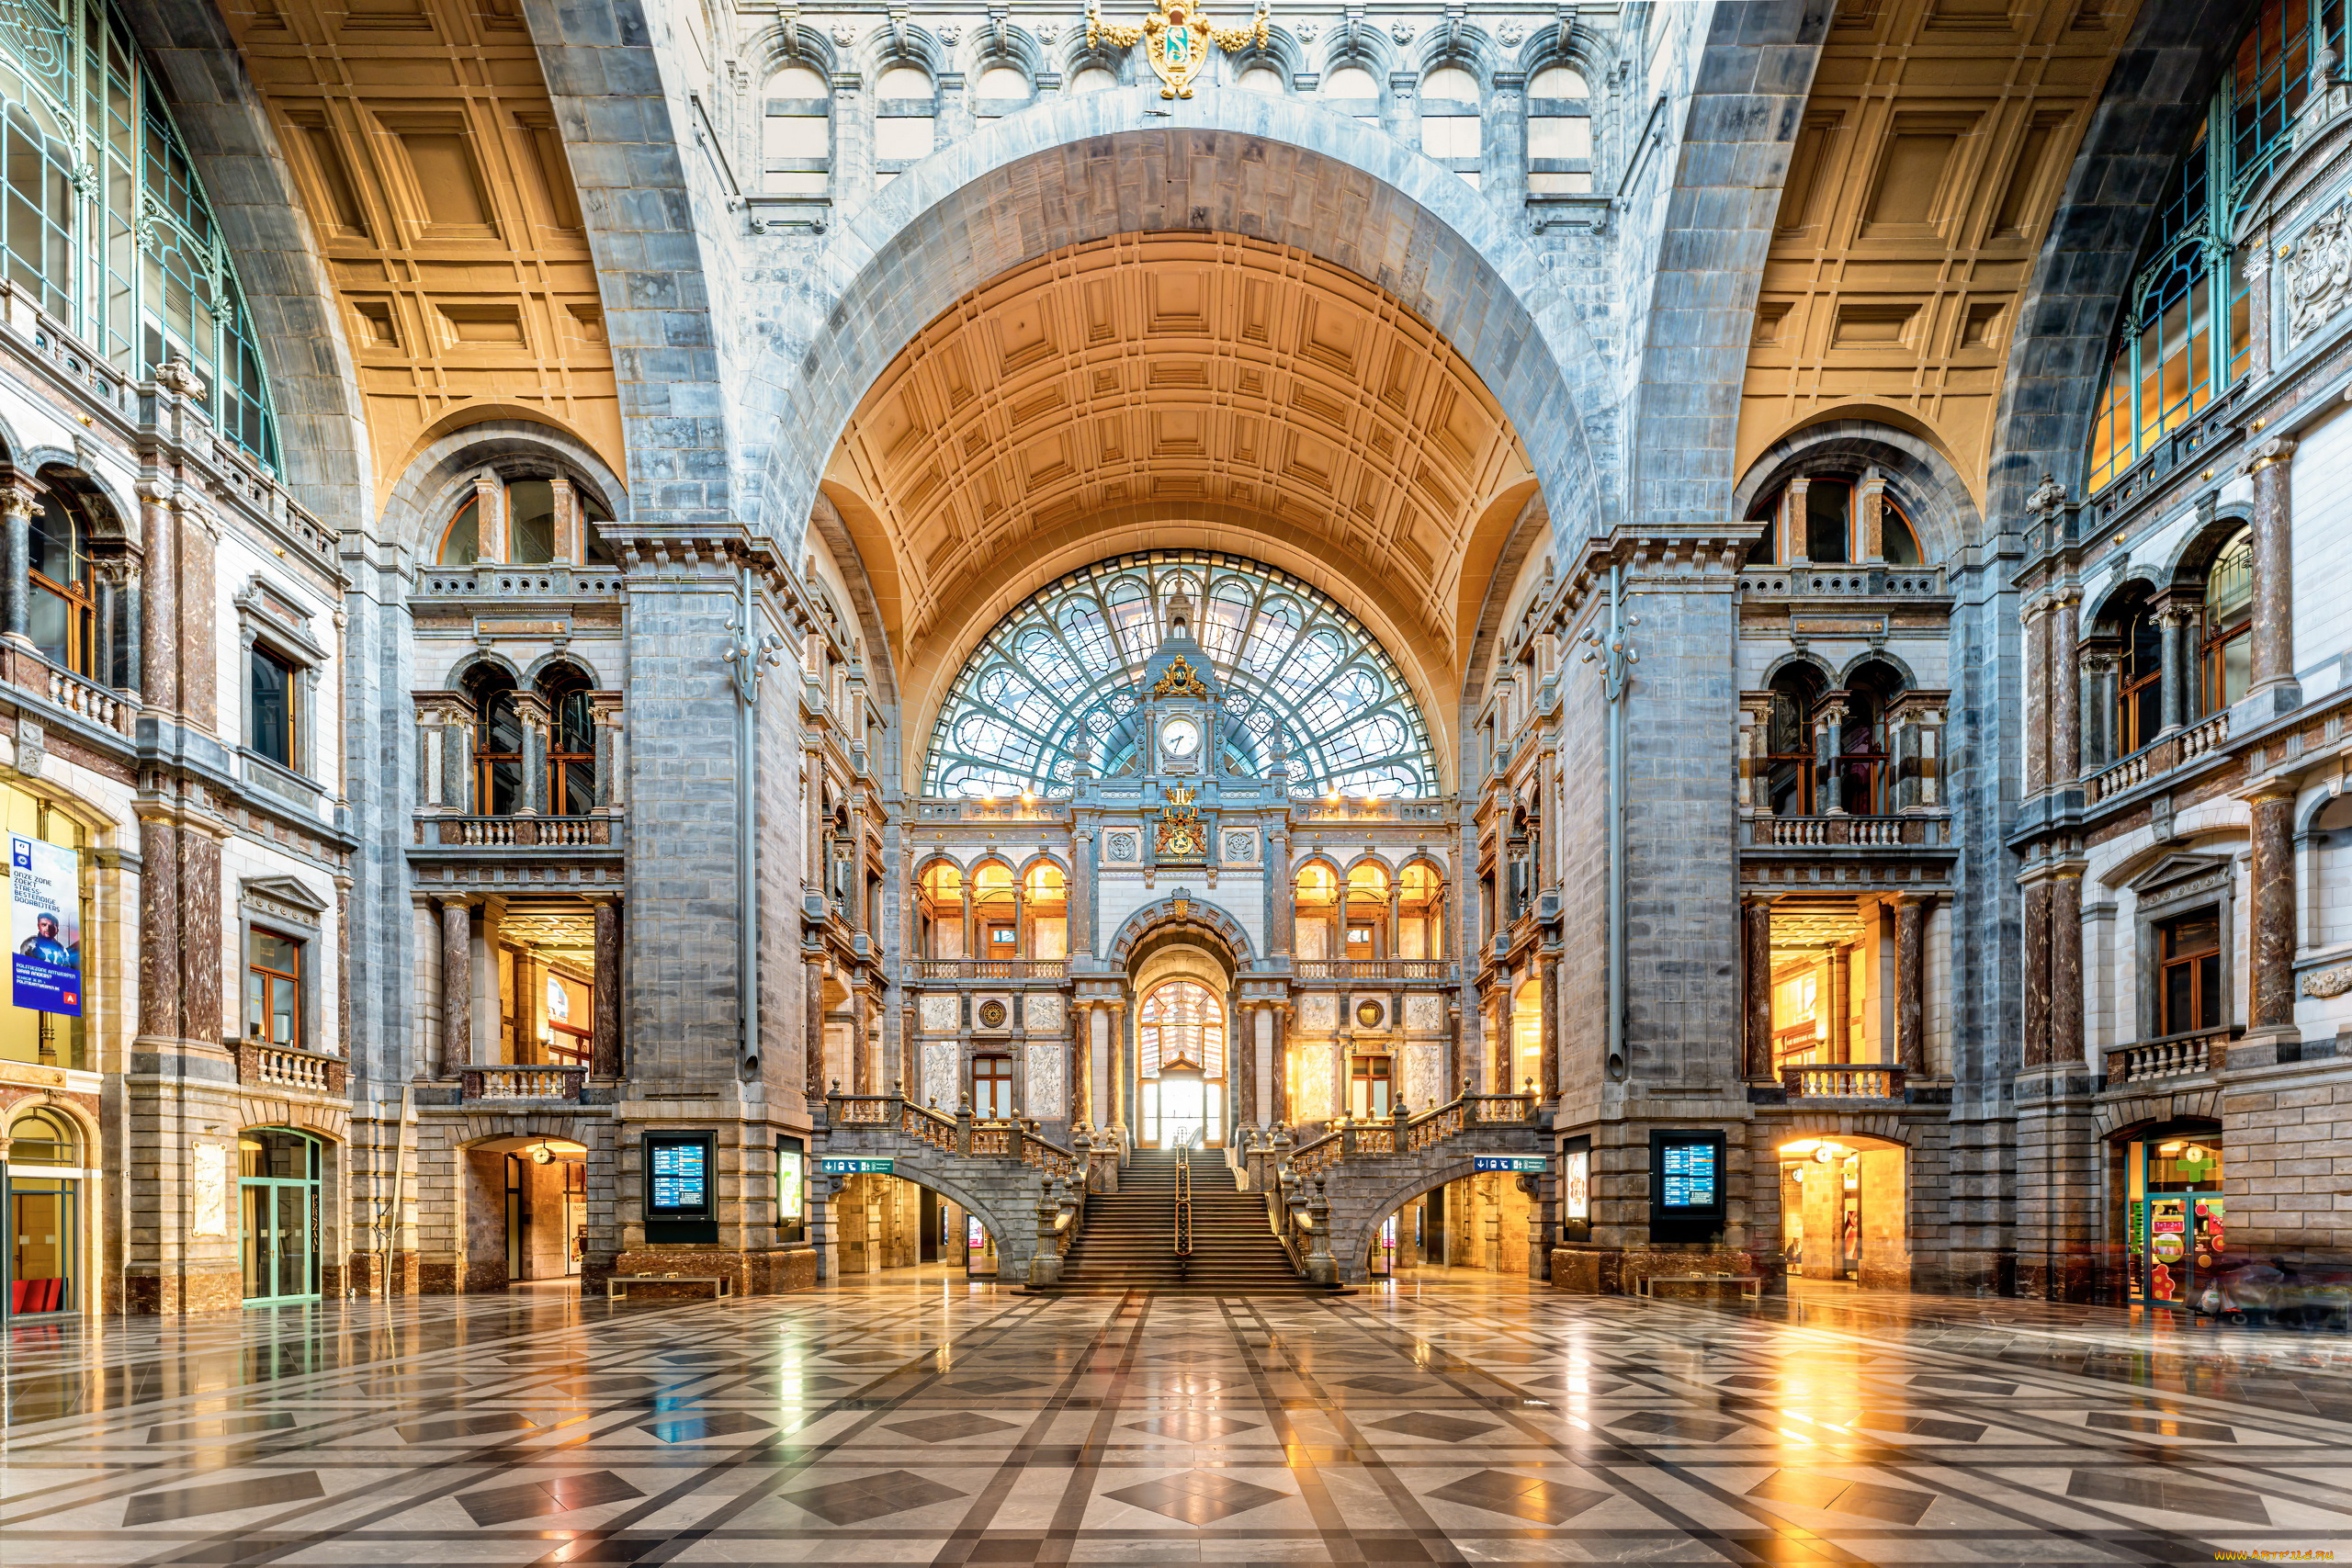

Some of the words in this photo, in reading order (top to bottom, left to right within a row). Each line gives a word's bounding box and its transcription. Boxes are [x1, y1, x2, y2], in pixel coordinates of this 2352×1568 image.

[1174, 671, 1187, 680] PAX
[14, 871, 32, 881] ONZE
[34, 876, 51, 886] ZONE
[14, 877, 37, 887] ZOEKT
[14, 884, 42, 895] STRESS-
[14, 889, 56, 905] BESTENDIGE
[15, 896, 60, 912] DOORBIJTERS
